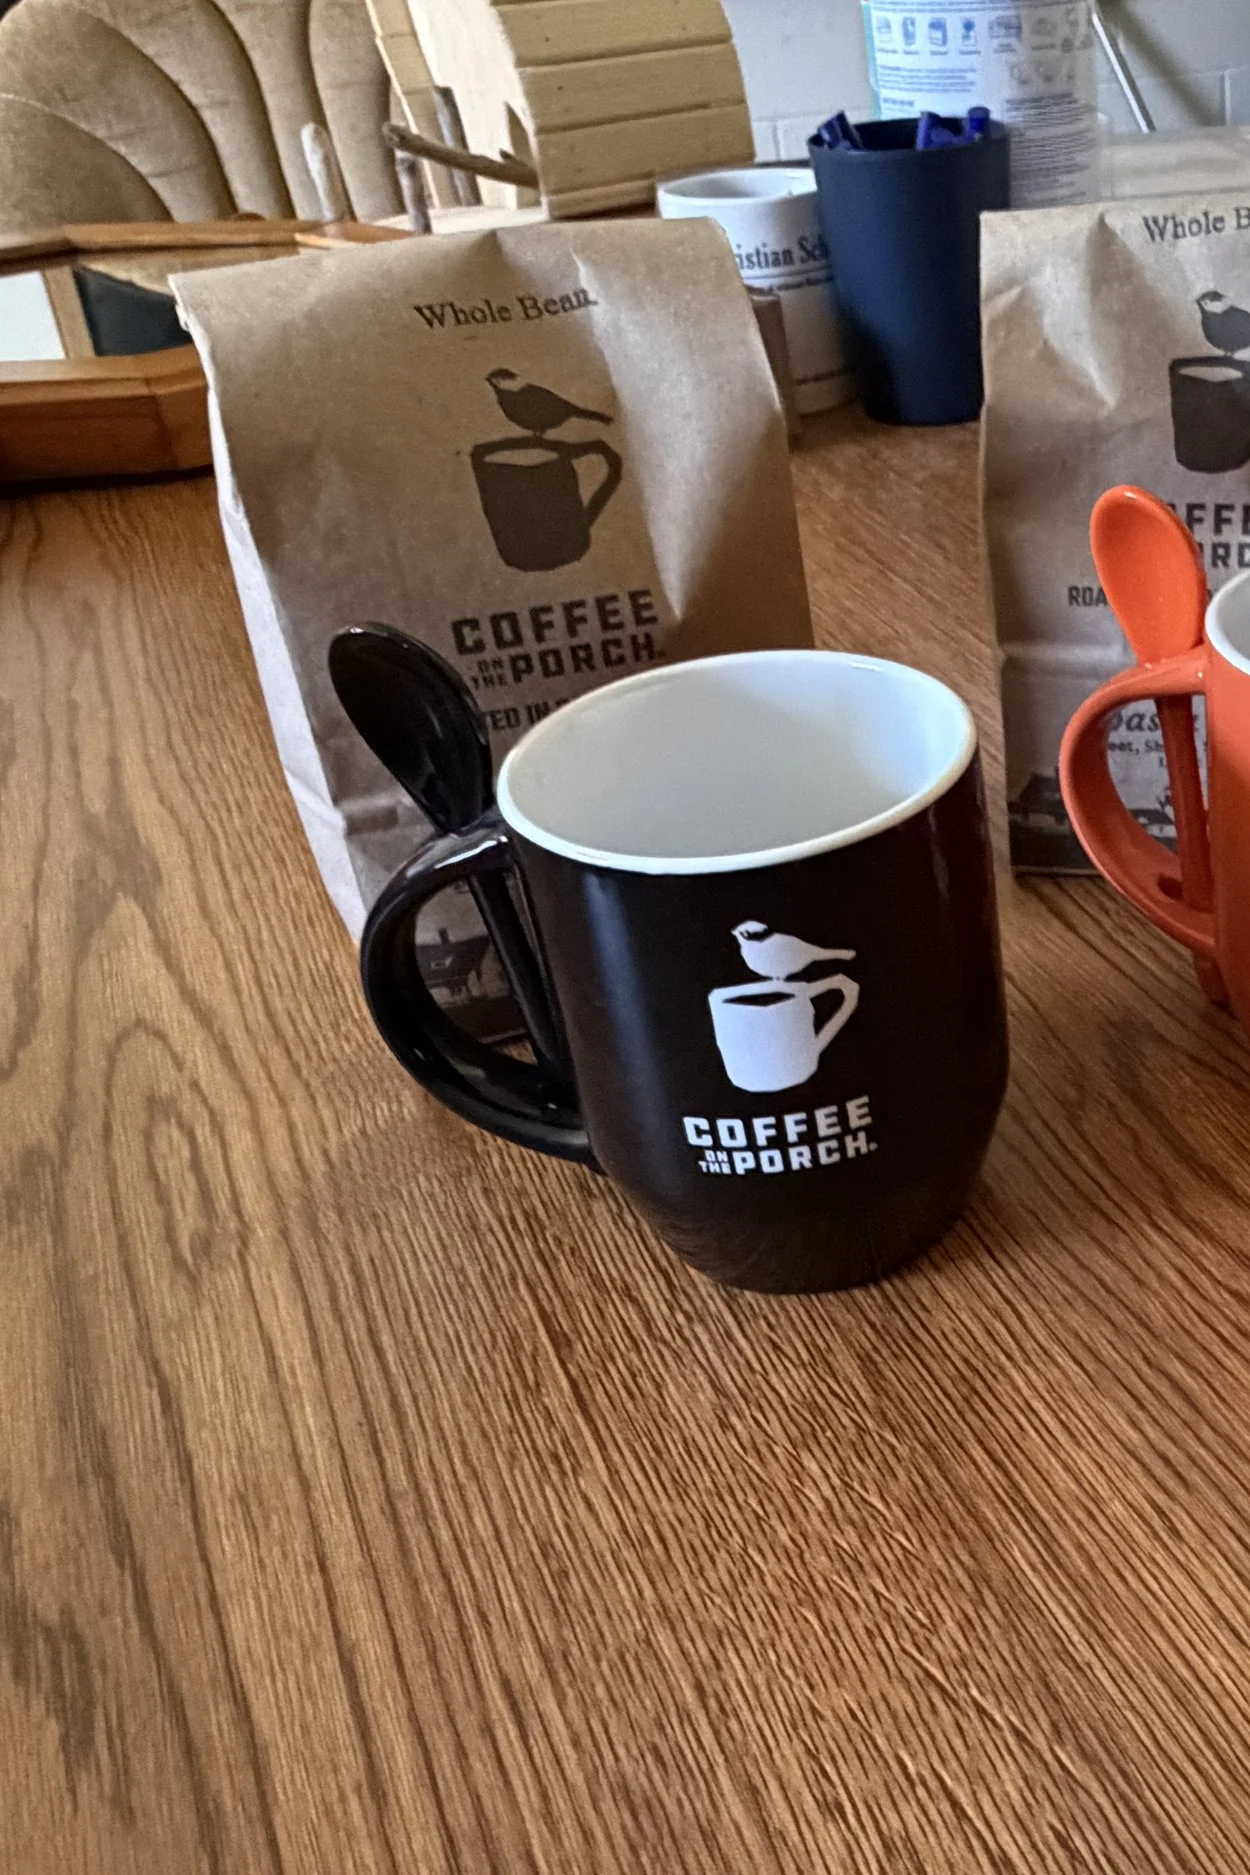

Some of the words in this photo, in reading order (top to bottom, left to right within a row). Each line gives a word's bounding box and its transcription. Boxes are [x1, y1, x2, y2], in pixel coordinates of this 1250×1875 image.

[1142, 208, 1226, 243] Whole
[735, 241, 795, 271] istian
[413, 298, 513, 330] Whole
[516, 288, 599, 321] Bean
[451, 589, 658, 656] COFFEE
[683, 1095, 873, 1147] COFFEE
[698, 1161, 732, 1175] THE
[704, 1149, 728, 1162] ON
